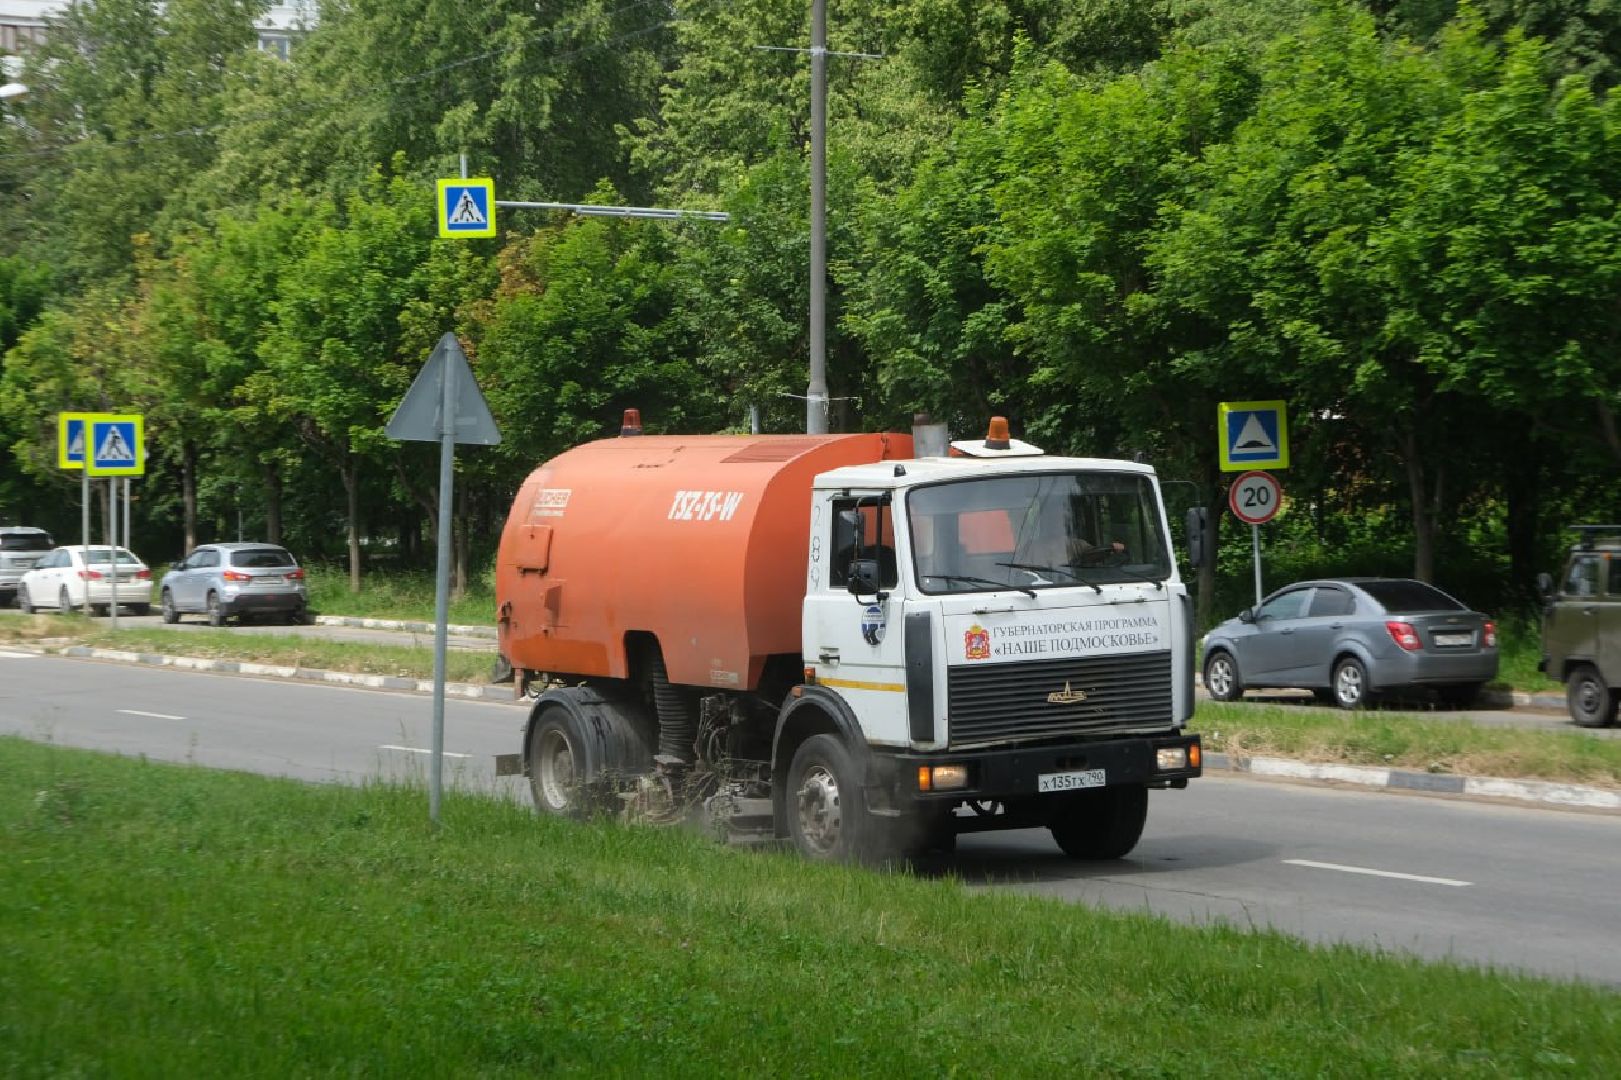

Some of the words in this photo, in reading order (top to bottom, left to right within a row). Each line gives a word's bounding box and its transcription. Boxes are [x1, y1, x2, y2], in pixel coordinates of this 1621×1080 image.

[1243, 486, 1269, 507] 20
[993, 622, 1092, 638] ГУБЕРНАТОРСКАЯ
[1095, 616, 1158, 631] ПРОГРАММА
[994, 639, 1047, 656] «НАШЕ
[1051, 633, 1158, 652] ПОДМОСКОВЬЕ»
